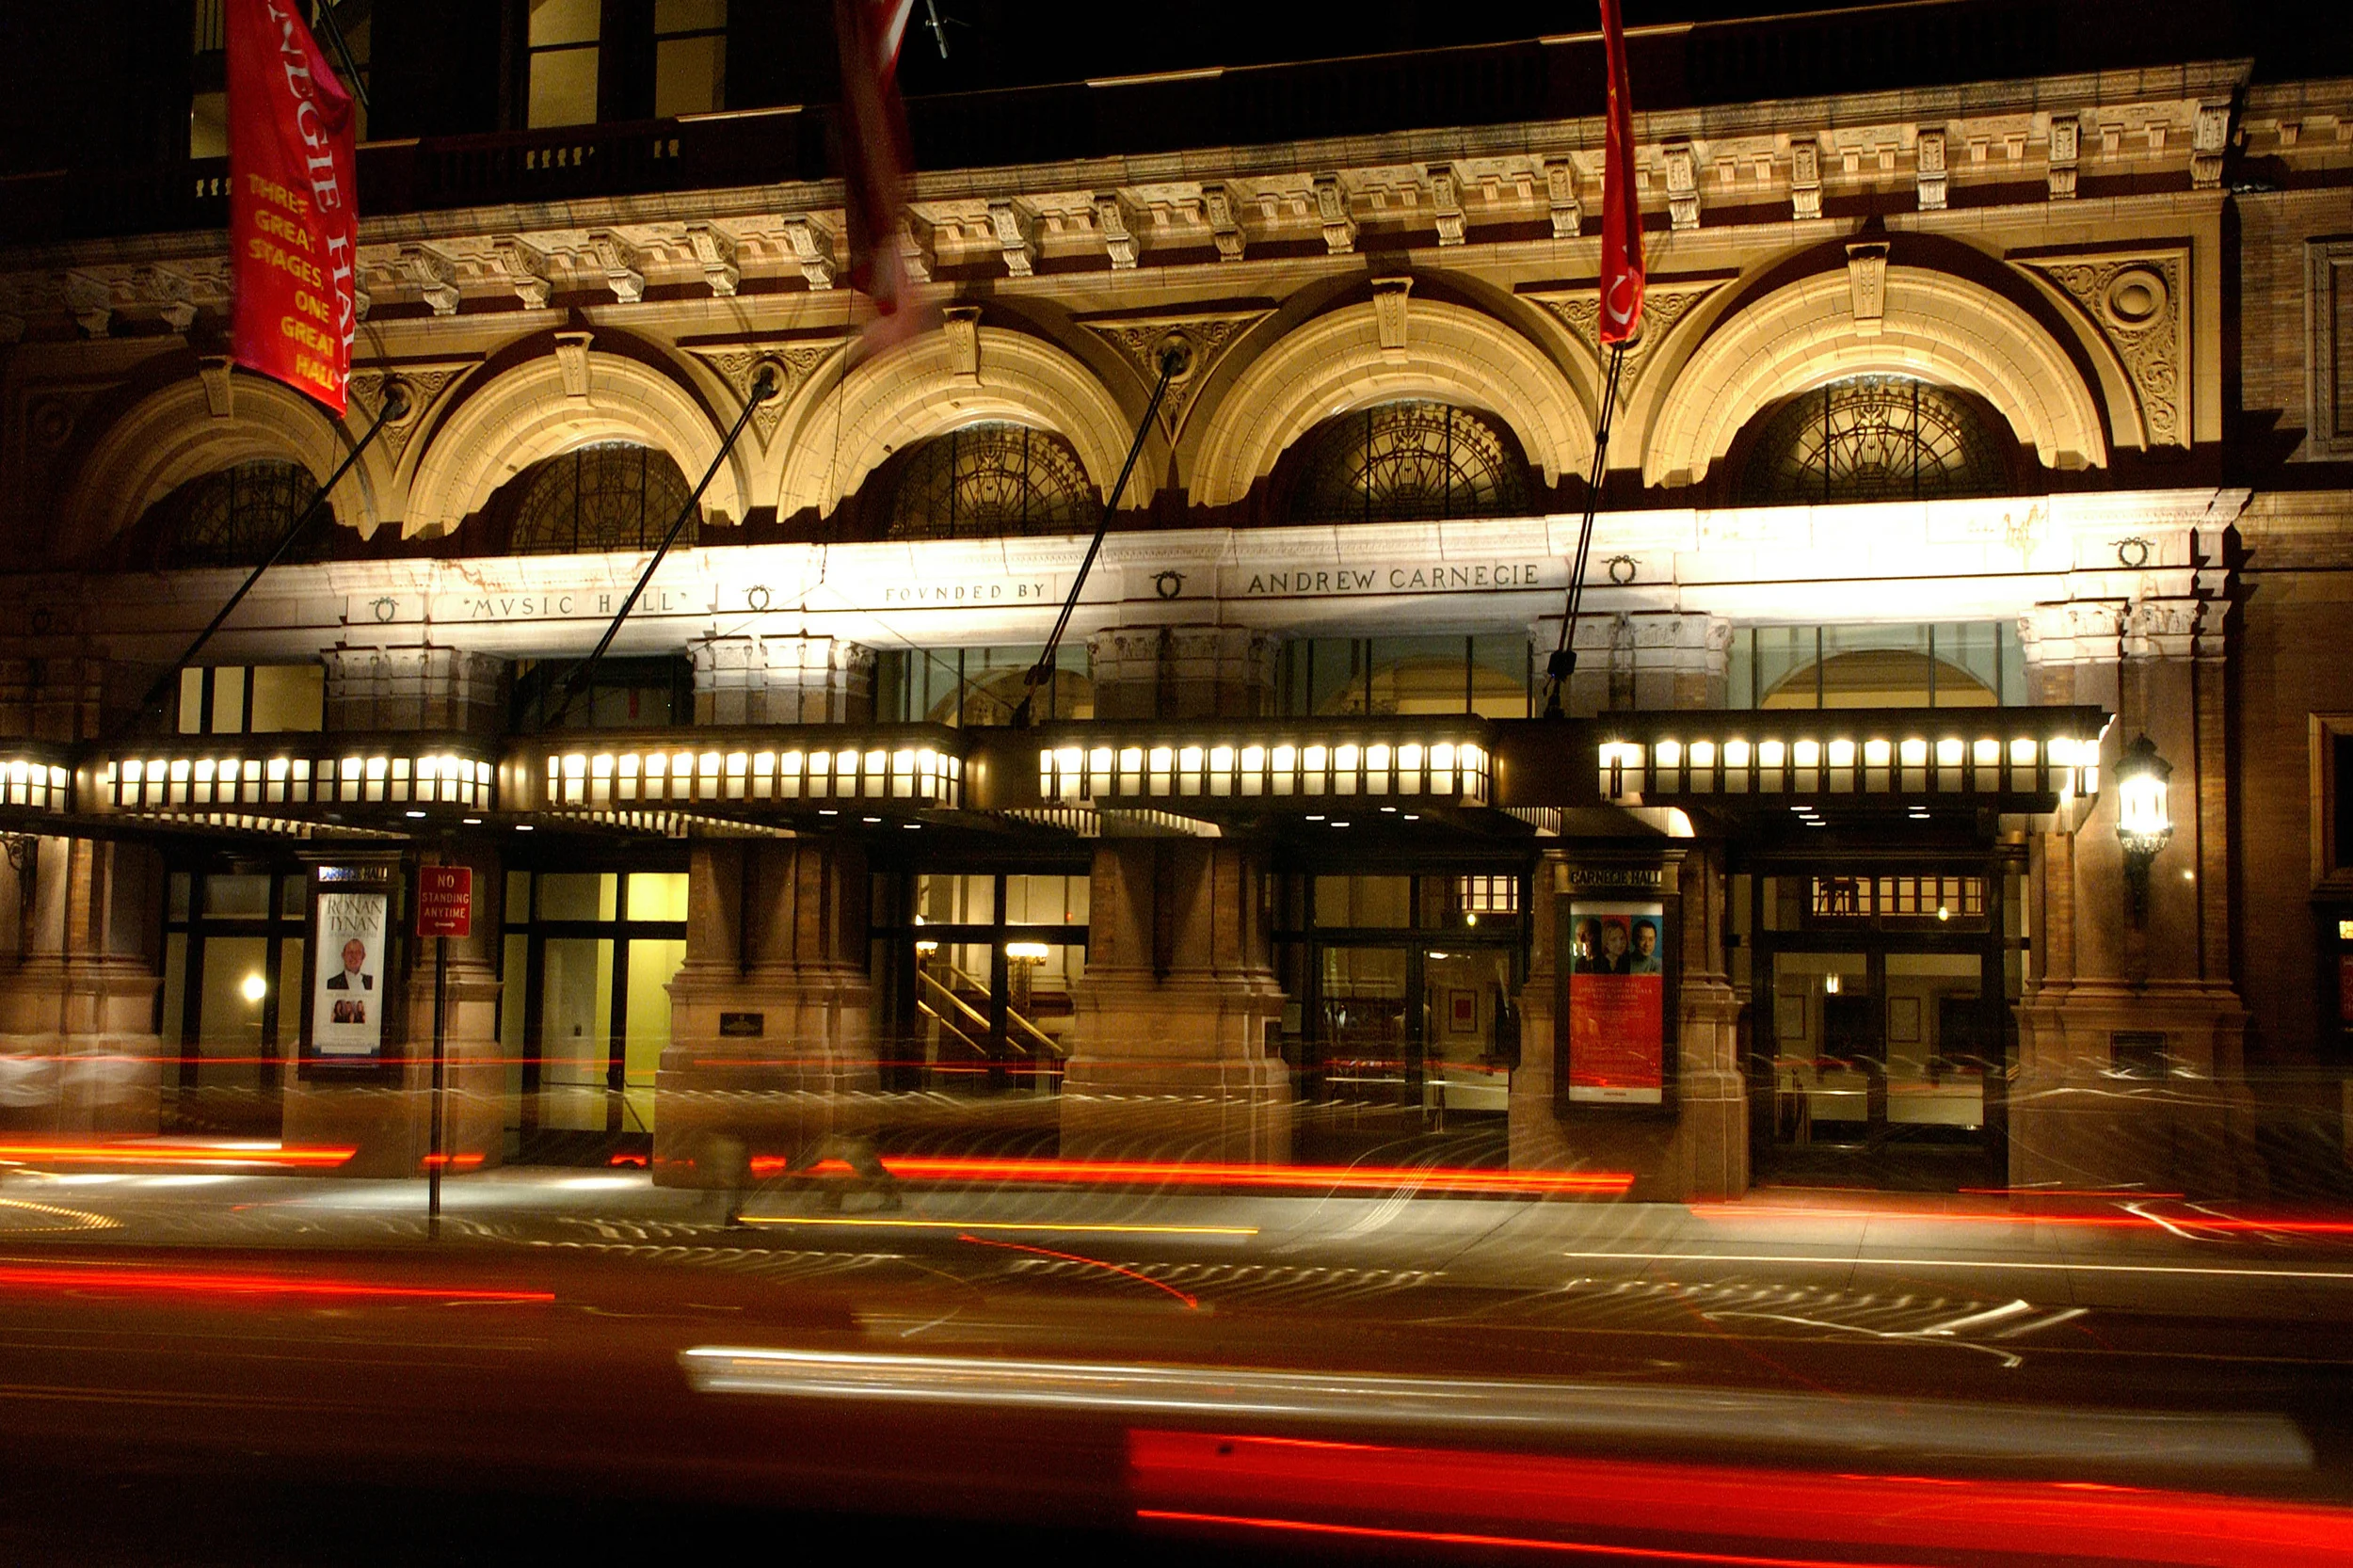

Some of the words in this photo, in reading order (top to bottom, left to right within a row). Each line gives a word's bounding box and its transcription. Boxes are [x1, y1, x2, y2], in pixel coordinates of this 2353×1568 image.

[248, 238, 325, 292] STAGES,
[295, 290, 329, 324] ONE
[280, 316, 335, 358] GREAT
[296, 354, 336, 392] HALL
[1248, 569, 1376, 594] ANDREW
[1389, 565, 1540, 589] CARNEGIE
[1017, 583, 1045, 599] BY
[437, 873, 455, 888] NO
[1571, 871, 1629, 886] CARNEGIE
[1631, 870, 1662, 886] HALL
[421, 891, 470, 904] STANDING
[327, 899, 384, 915] RONAN
[424, 906, 467, 920] ANYTIME
[330, 916, 379, 931] TYNAN
